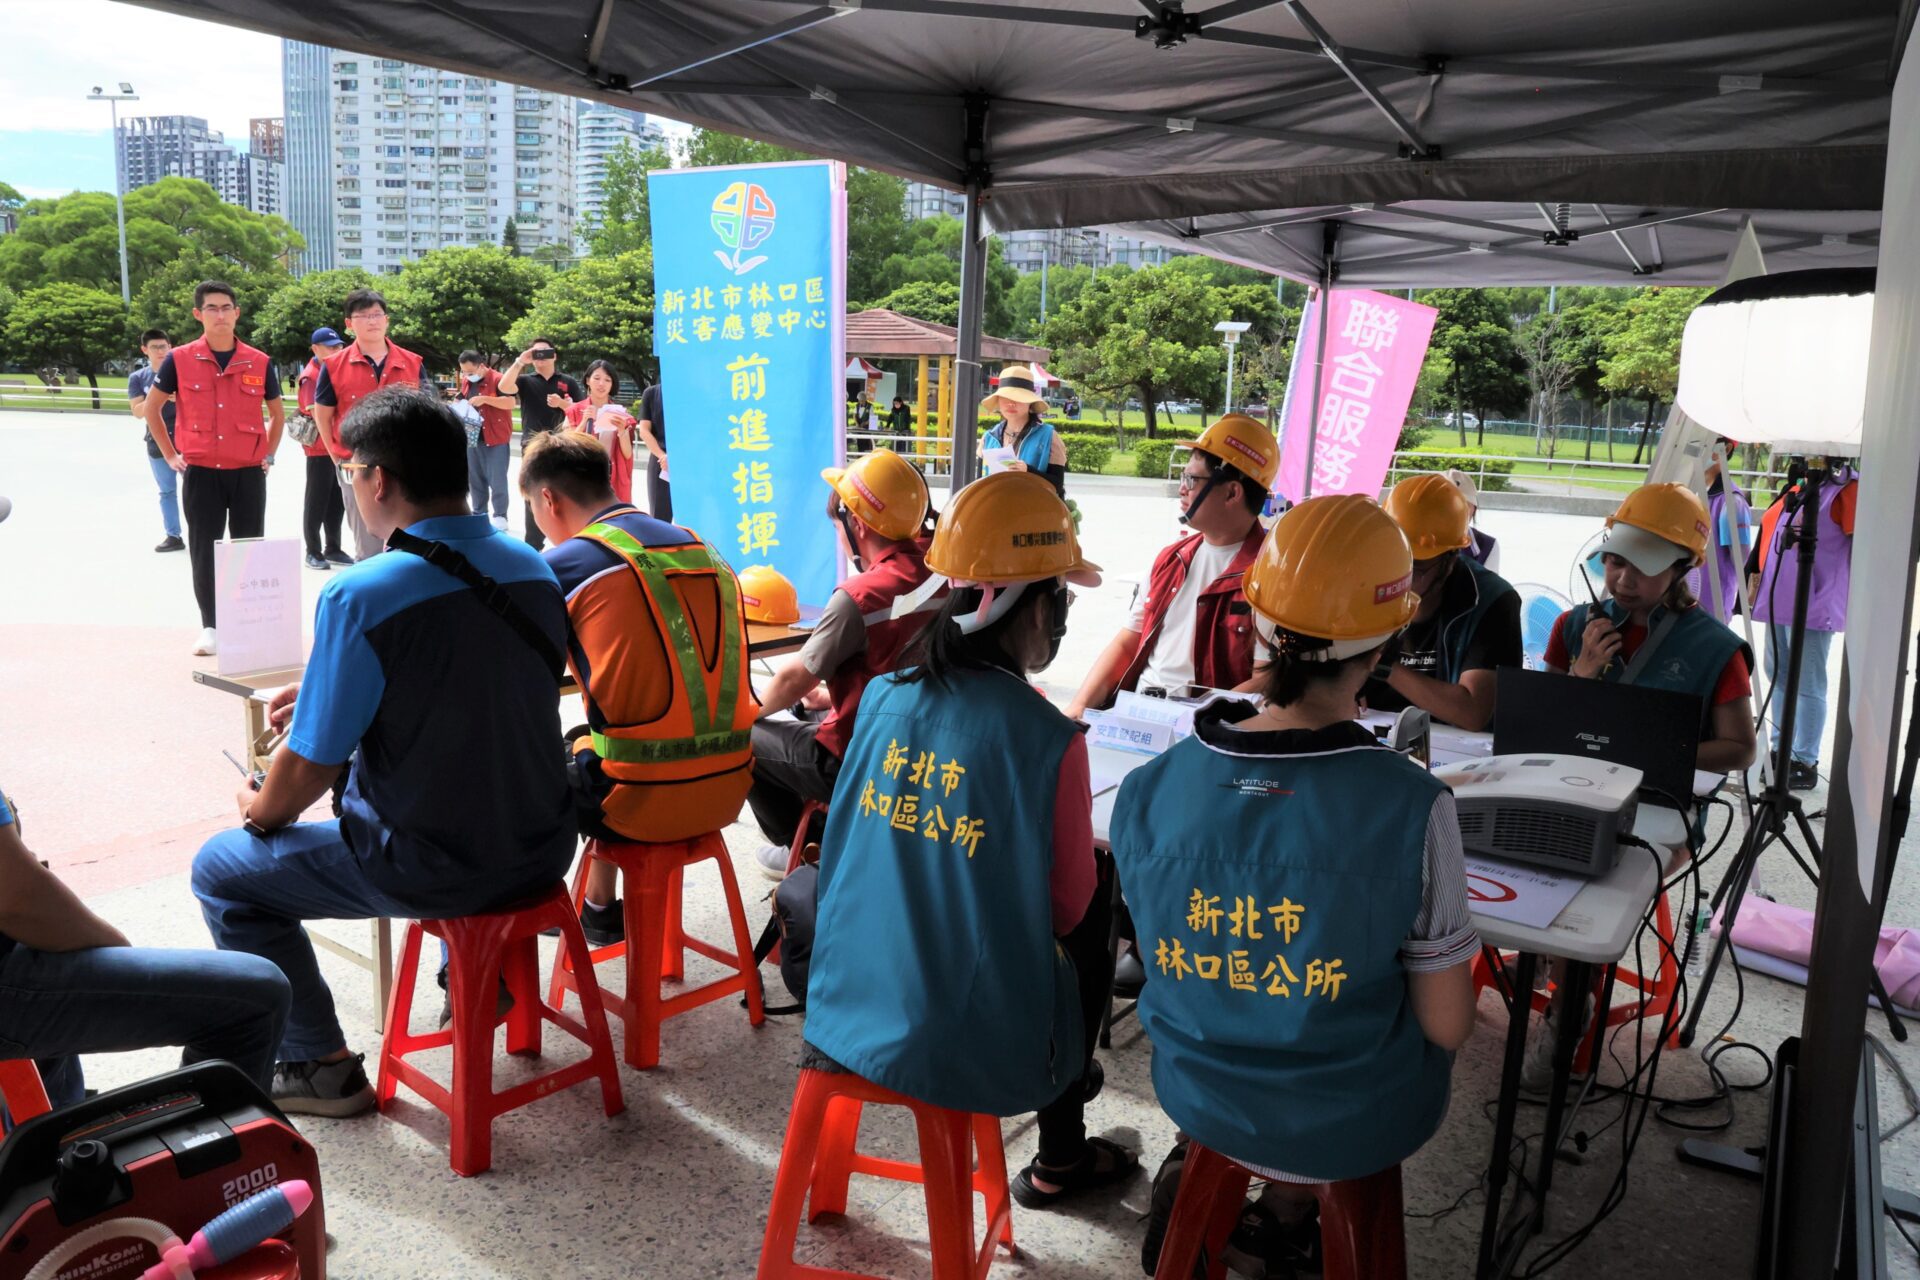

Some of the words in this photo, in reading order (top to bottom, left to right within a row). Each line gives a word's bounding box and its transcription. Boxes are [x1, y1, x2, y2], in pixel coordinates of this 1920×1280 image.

[661, 276, 825, 315] 新北市林口區
[665, 308, 827, 345] 災害應變中心
[1311, 299, 1400, 497] 聯合服務
[726, 352, 780, 567] 前進指揮
[1576, 733, 1610, 744] ASUS
[882, 738, 966, 798] 新北市
[1233, 778, 1279, 788] LATITUDE
[859, 779, 986, 858] 林口區公所
[1186, 888, 1305, 945] 新北市
[1154, 937, 1348, 1002] 林口區公所
[222, 1162, 278, 1200] 2000
[52, 1243, 144, 1280] HINKOMI
